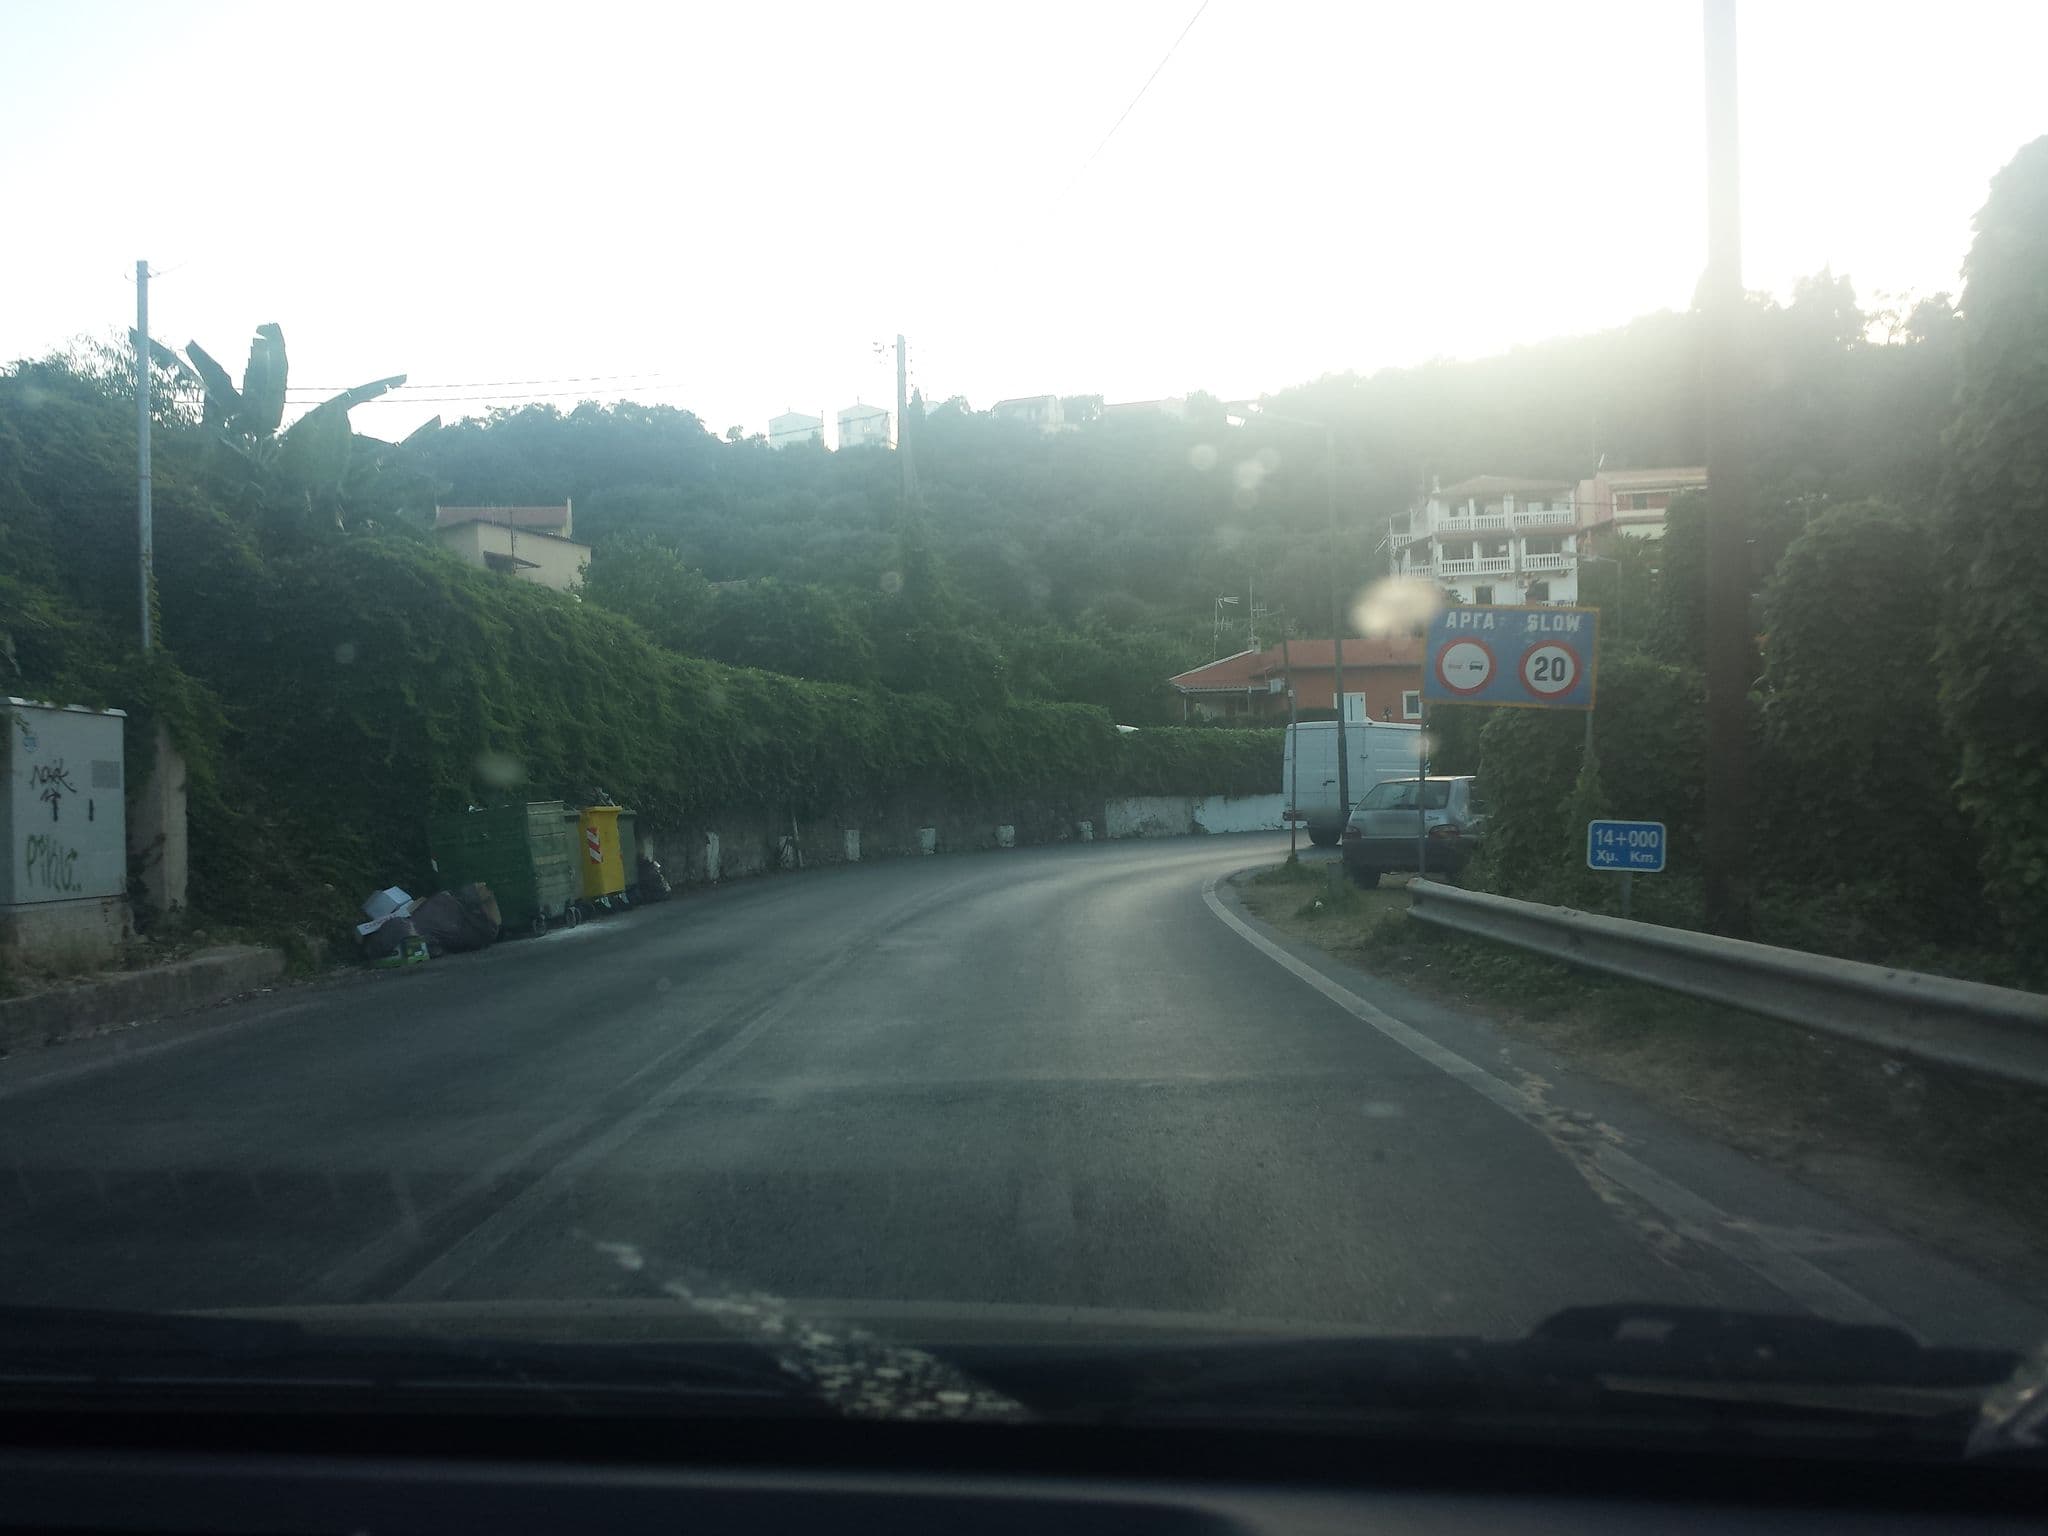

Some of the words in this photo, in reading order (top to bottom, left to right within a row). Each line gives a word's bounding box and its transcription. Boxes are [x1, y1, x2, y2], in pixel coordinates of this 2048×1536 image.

[1526, 613, 1581, 633] SLOW
[1533, 655, 1566, 682] 20
[1595, 828, 1659, 848] 14+000
